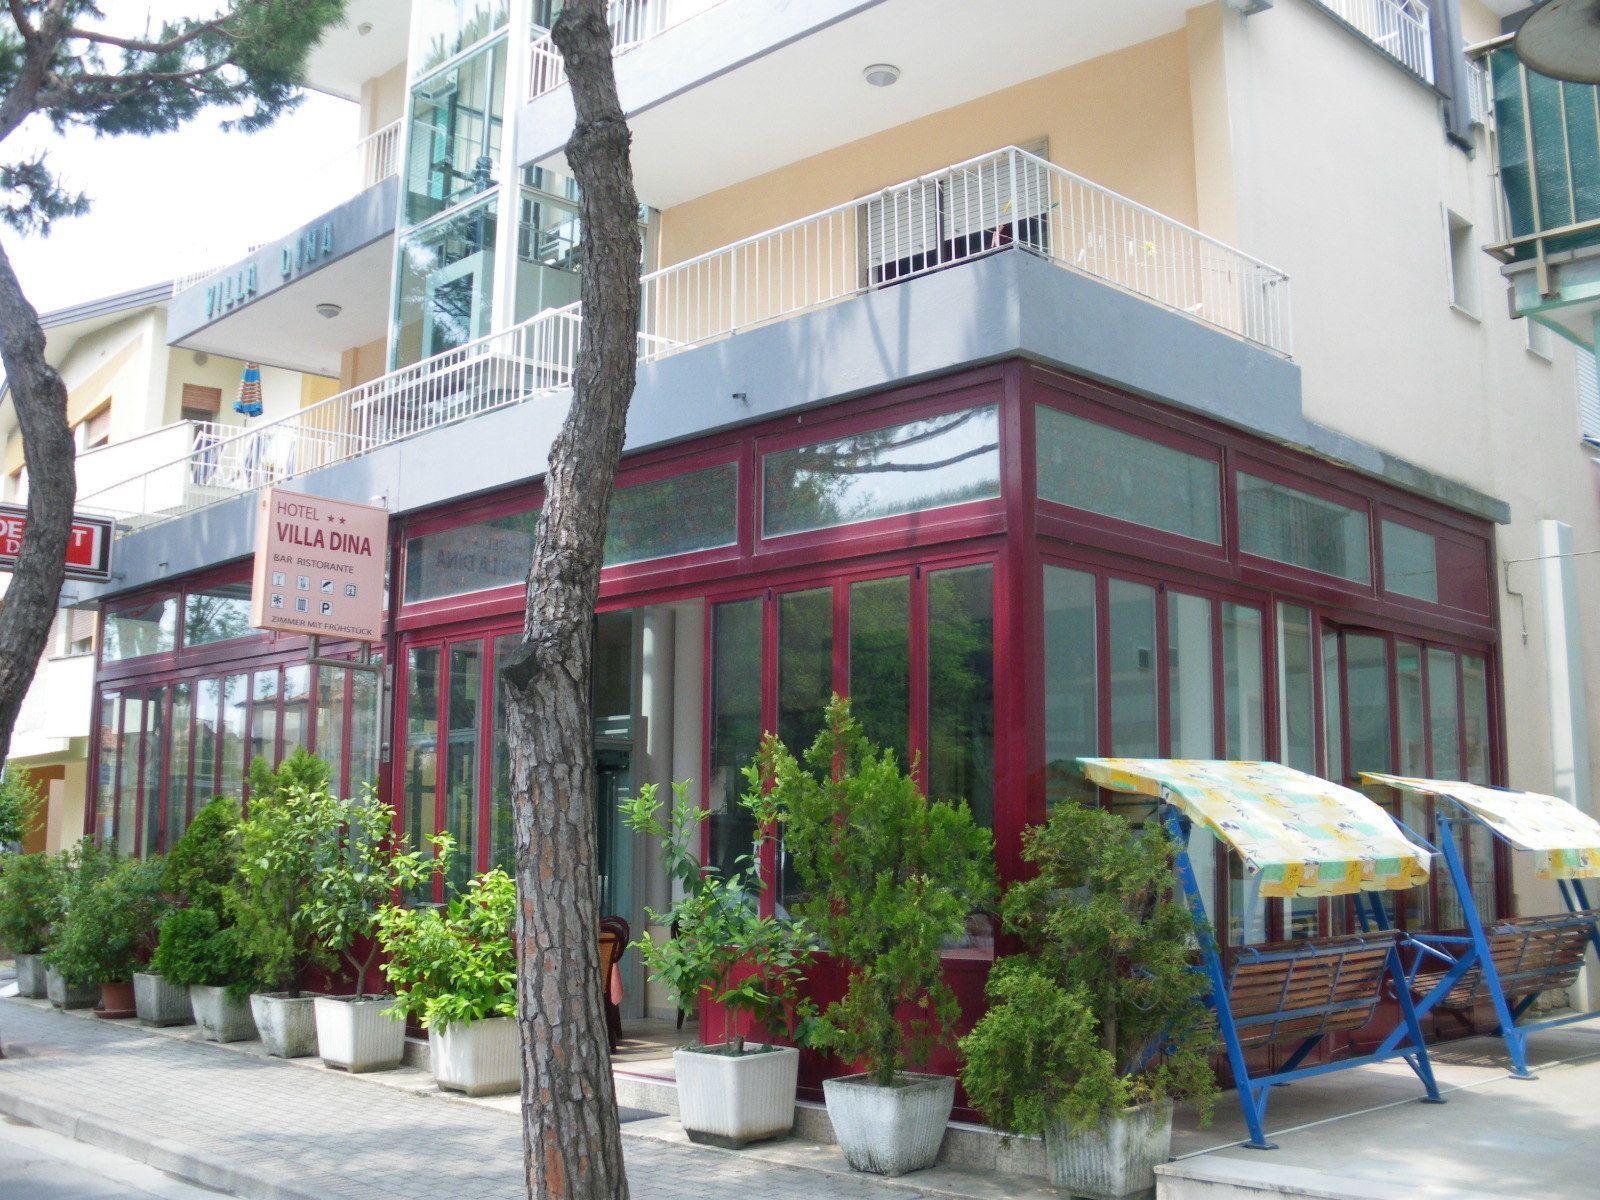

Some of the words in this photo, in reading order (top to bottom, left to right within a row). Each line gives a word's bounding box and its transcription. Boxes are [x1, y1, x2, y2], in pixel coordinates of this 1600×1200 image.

[206, 262, 257, 318] VILLA
[280, 222, 334, 279] DINA
[277, 502, 320, 521] HOTEL
[276, 521, 325, 549] VILLA
[329, 531, 372, 557] DINA
[273, 553, 293, 564] BAR
[297, 558, 354, 574] RISTORANTE
[321, 603, 330, 614] P
[271, 616, 306, 627] ZIMMER
[307, 621, 323, 629] MIT
